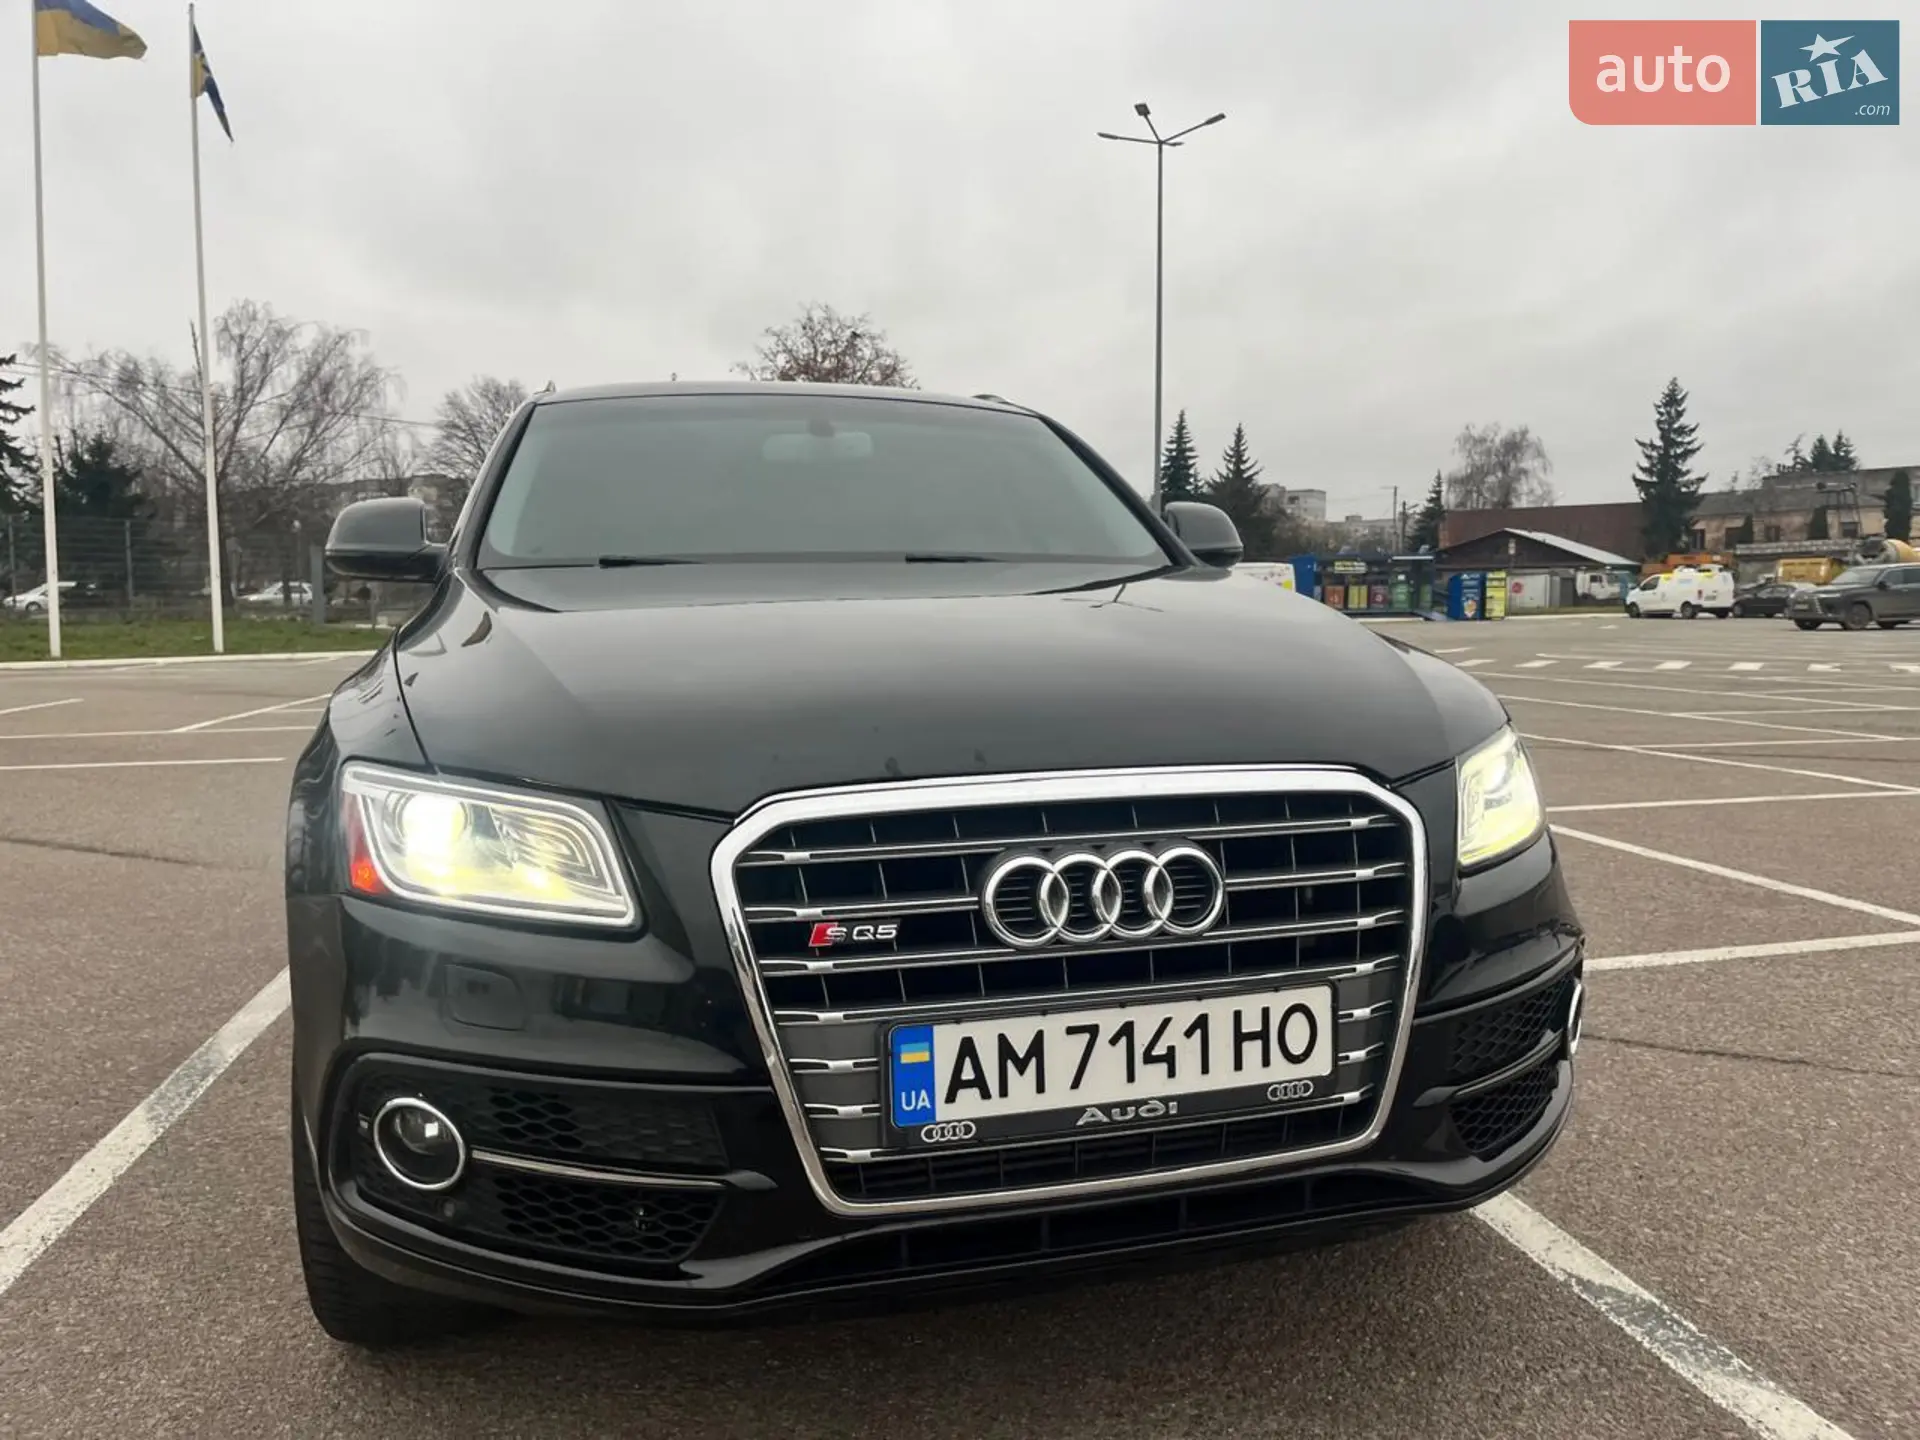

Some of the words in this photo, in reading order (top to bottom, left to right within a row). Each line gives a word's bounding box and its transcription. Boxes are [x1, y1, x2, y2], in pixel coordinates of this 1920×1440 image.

[944, 1029, 1046, 1104] AM
[1065, 1013, 1210, 1089] 7141
[1233, 1003, 1318, 1072] HO
[901, 1089, 931, 1111] UA
